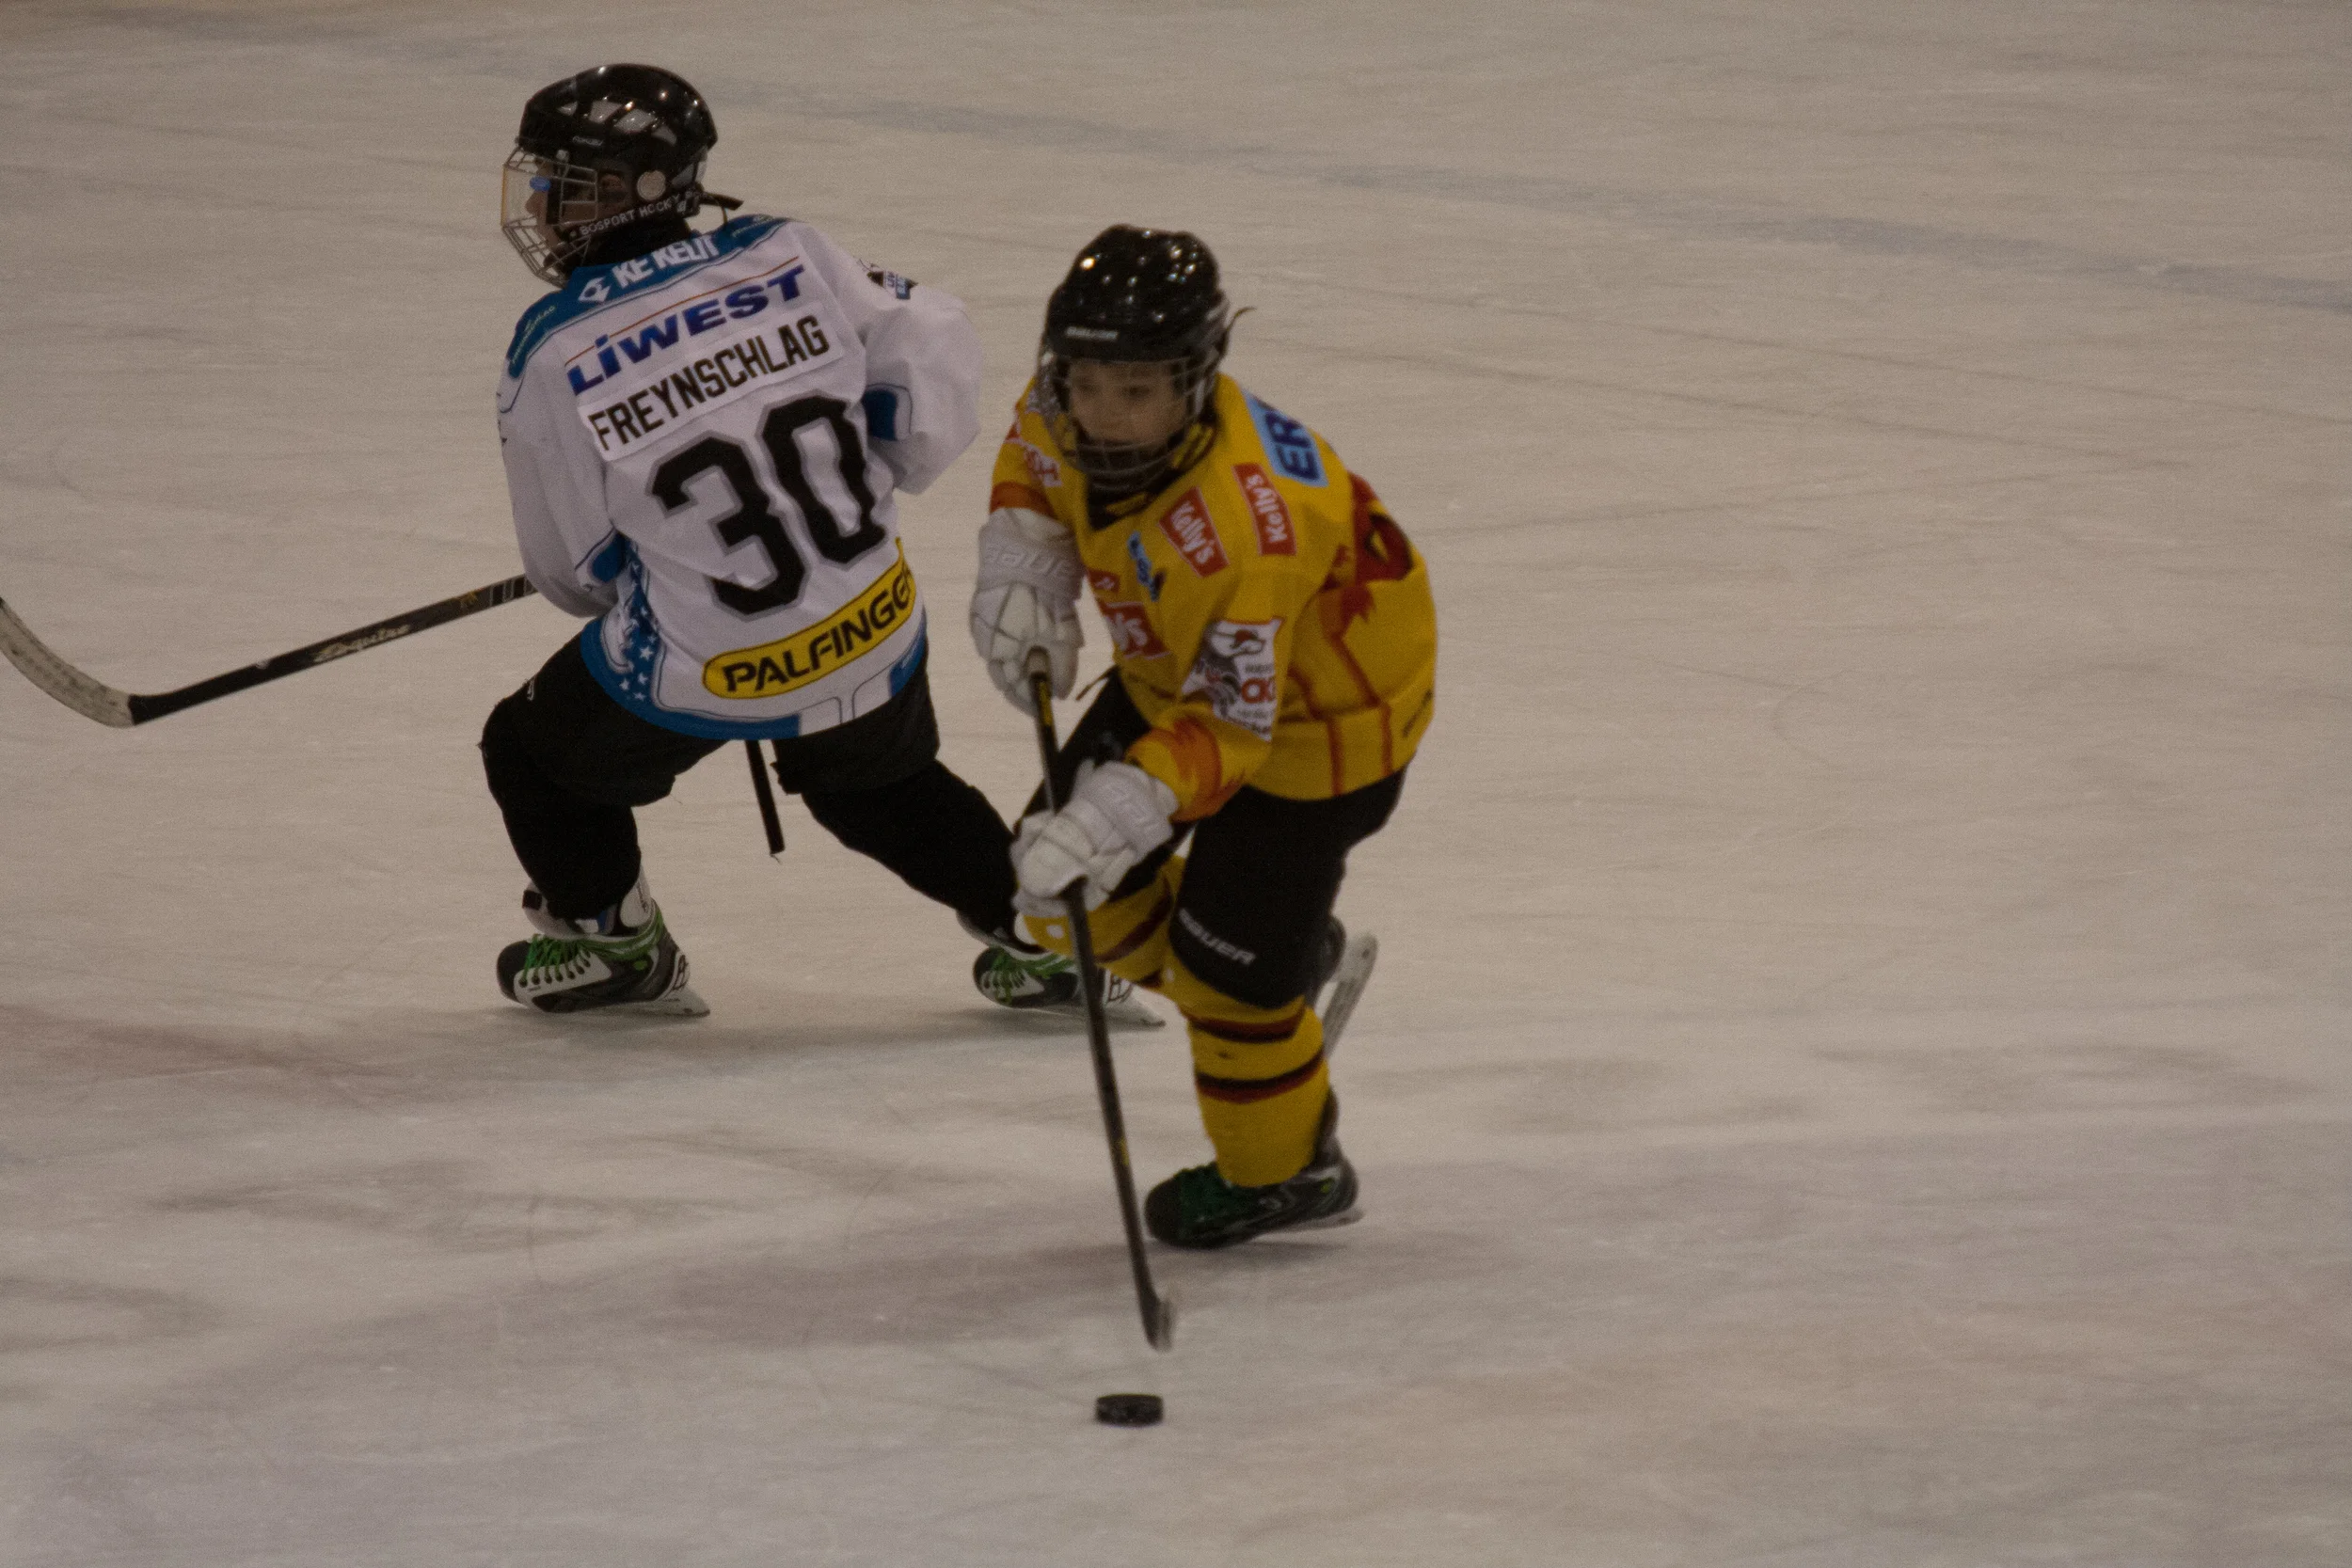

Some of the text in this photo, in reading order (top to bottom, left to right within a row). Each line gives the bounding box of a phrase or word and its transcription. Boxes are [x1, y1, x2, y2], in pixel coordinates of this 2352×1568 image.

[613, 258, 653, 288] KE
[587, 314, 830, 451] FREYNSCHLAG
[648, 391, 888, 620] 30
[1170, 500, 1216, 565] Kelly's
[1248, 473, 1289, 543] Kelly's
[723, 569, 912, 693] PALFINGE
